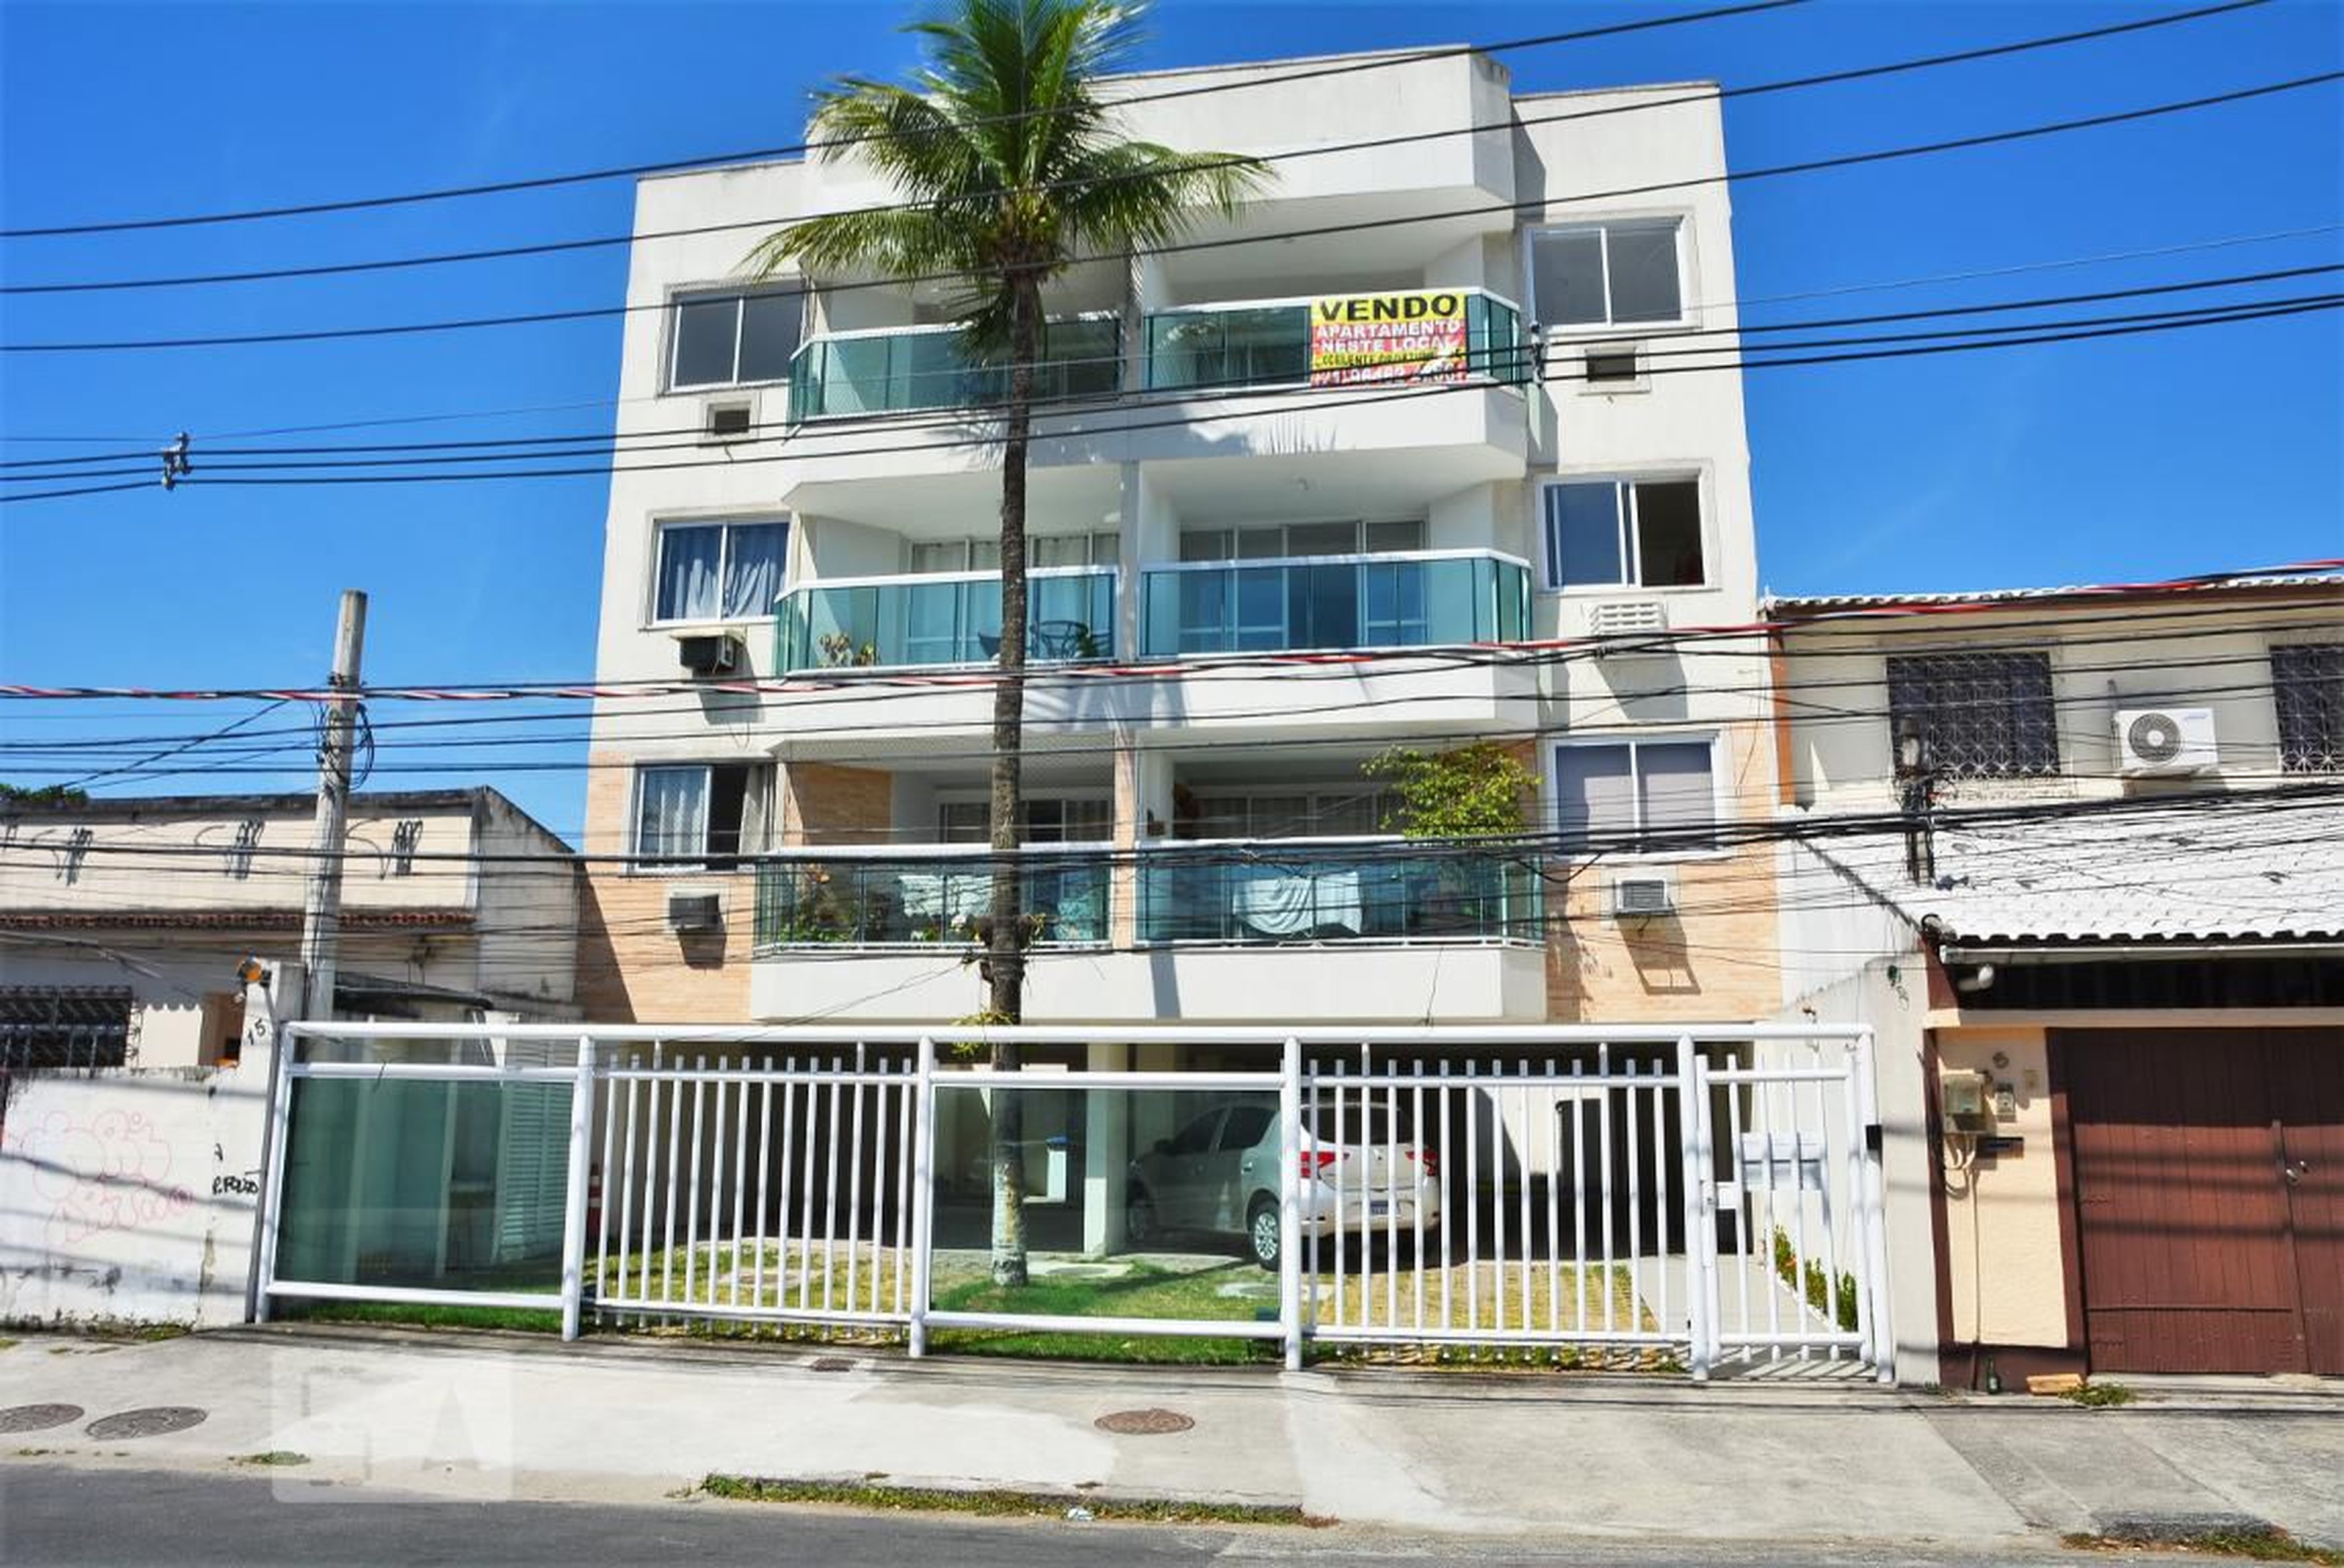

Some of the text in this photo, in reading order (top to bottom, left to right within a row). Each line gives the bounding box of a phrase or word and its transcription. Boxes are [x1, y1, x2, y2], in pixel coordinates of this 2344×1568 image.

[1320, 294, 1458, 321] VENDO
[1317, 319, 1460, 339] APARTAMENTO
[1322, 338, 1385, 353] NESTE
